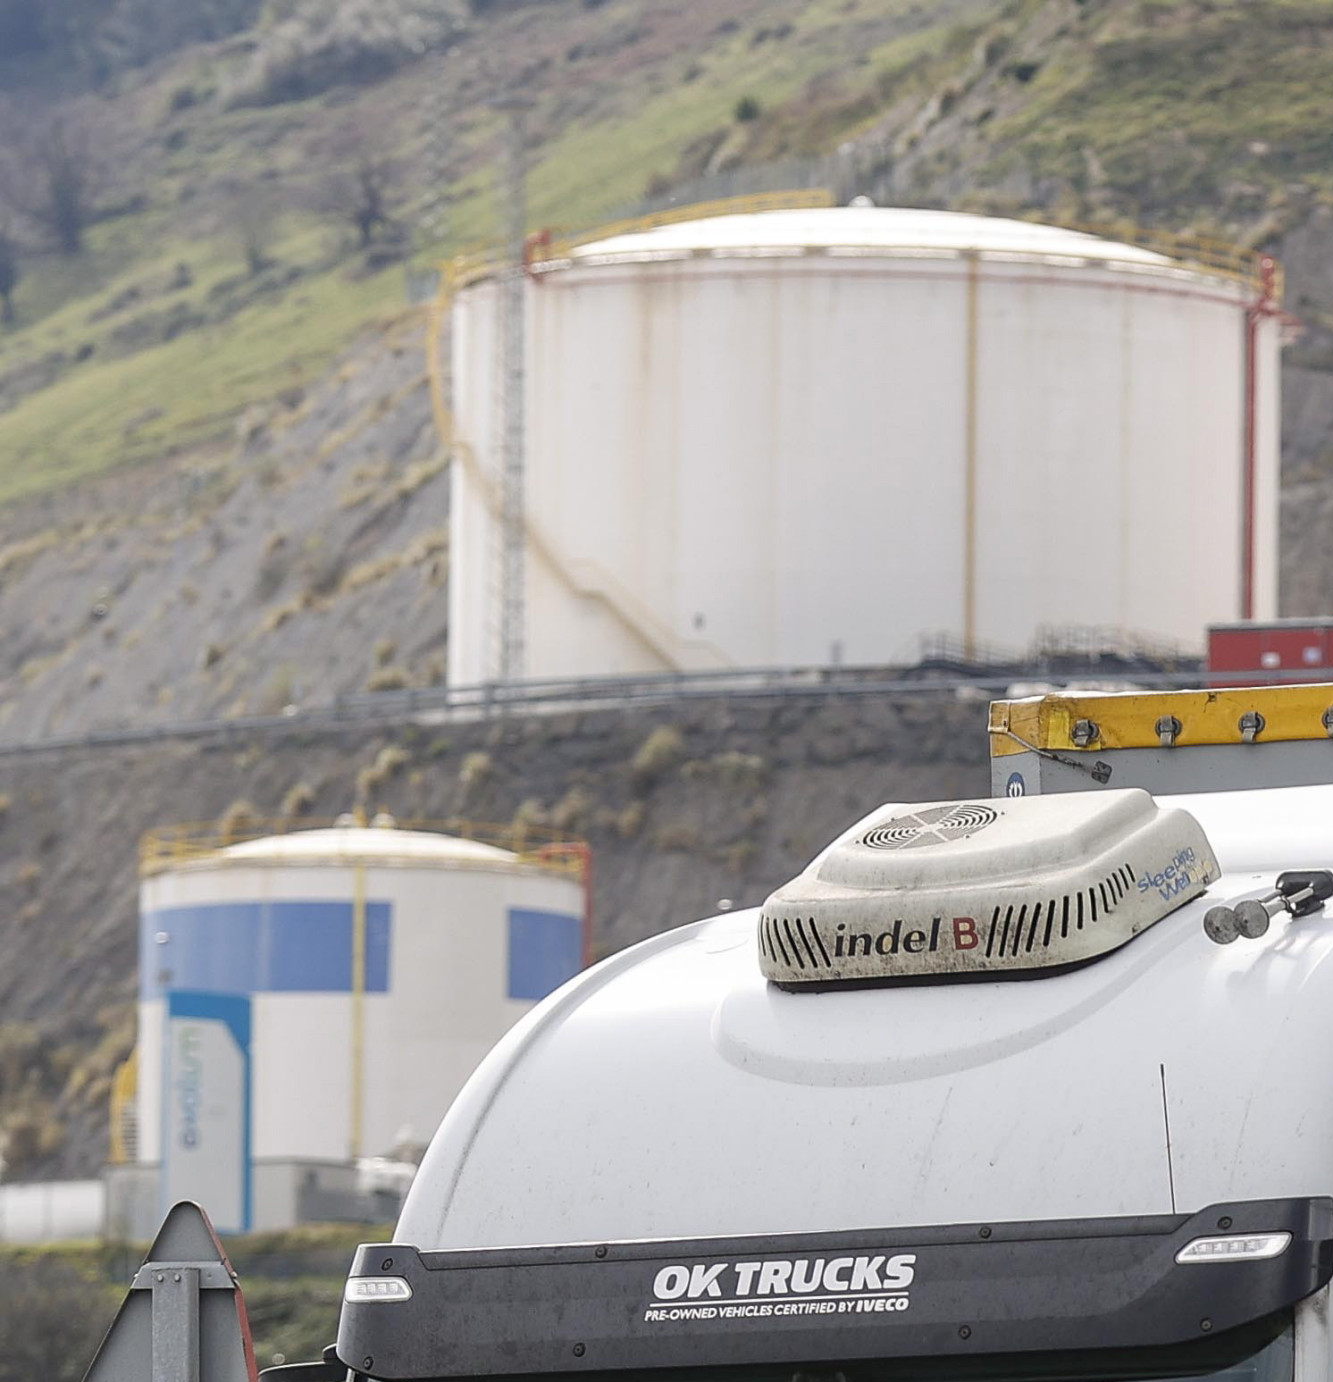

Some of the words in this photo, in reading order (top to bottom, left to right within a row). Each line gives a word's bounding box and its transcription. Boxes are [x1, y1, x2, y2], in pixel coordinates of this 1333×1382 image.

[834, 917, 941, 957] indel
[953, 917, 979, 951] B
[652, 1263, 729, 1300] OK
[735, 1254, 916, 1296] TRUCKS
[644, 1307, 718, 1322] PRE-OWNED
[719, 1304, 773, 1318] VEHICLES
[774, 1302, 837, 1316] CERTIFIED
[838, 1301, 855, 1313] BY
[856, 1298, 909, 1313] IVECO
